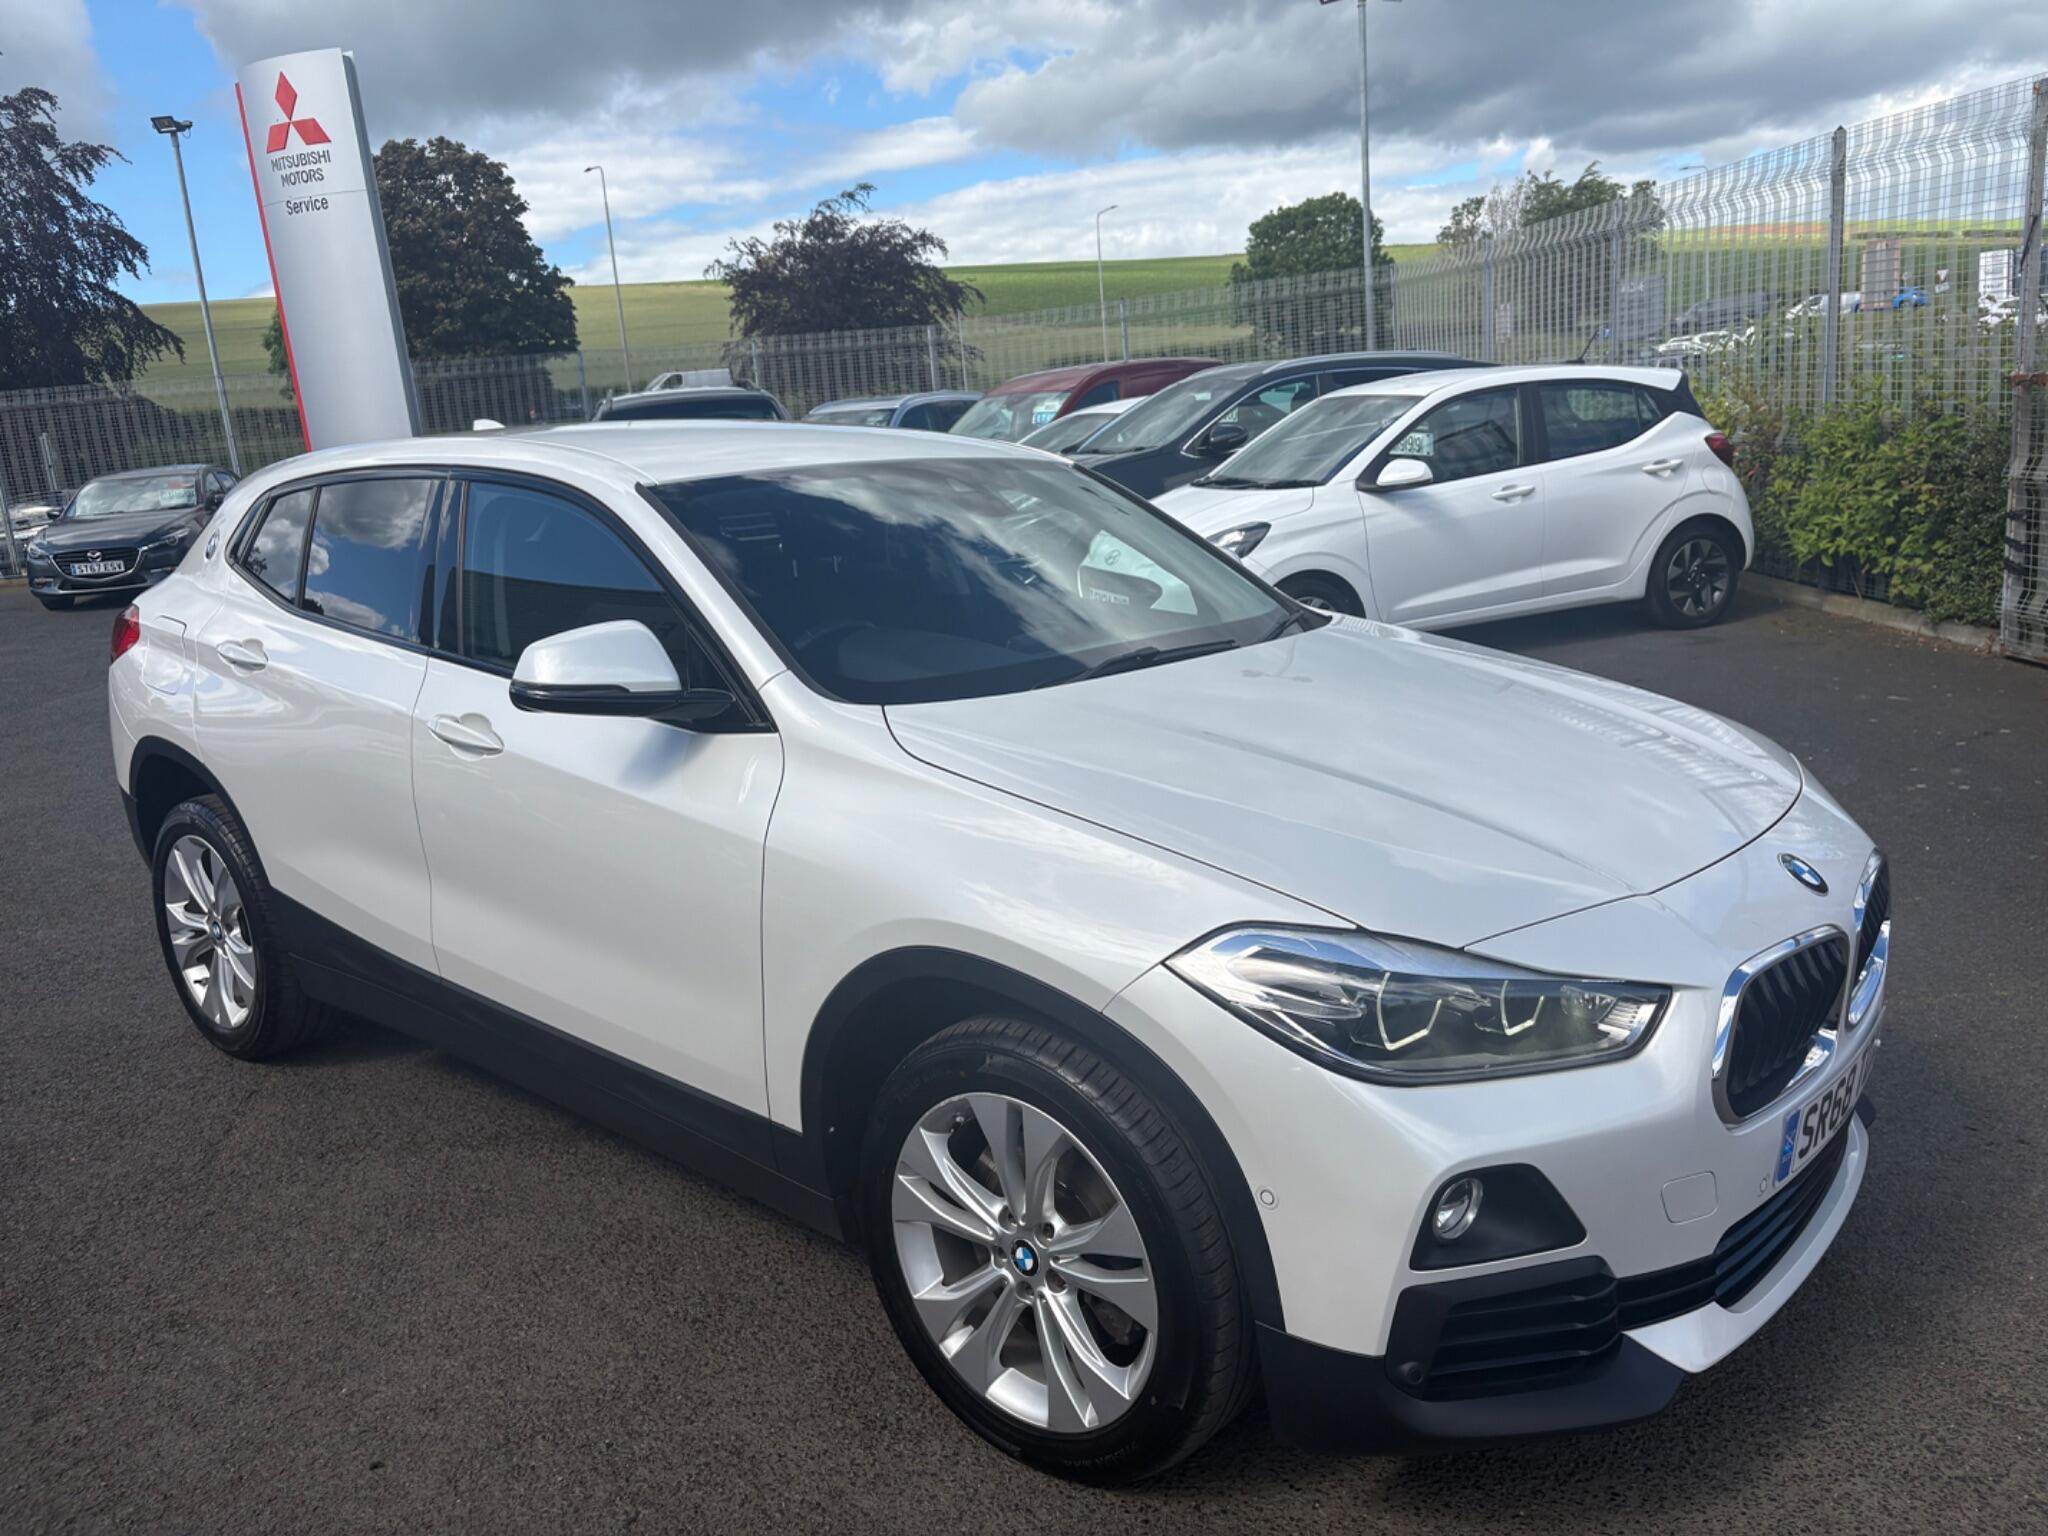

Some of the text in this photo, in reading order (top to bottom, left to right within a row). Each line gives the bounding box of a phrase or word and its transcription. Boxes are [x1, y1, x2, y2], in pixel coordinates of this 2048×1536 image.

[271, 150, 331, 172] MITSUBISHI
[281, 168, 325, 187] MOTORS
[286, 196, 329, 215] Service
